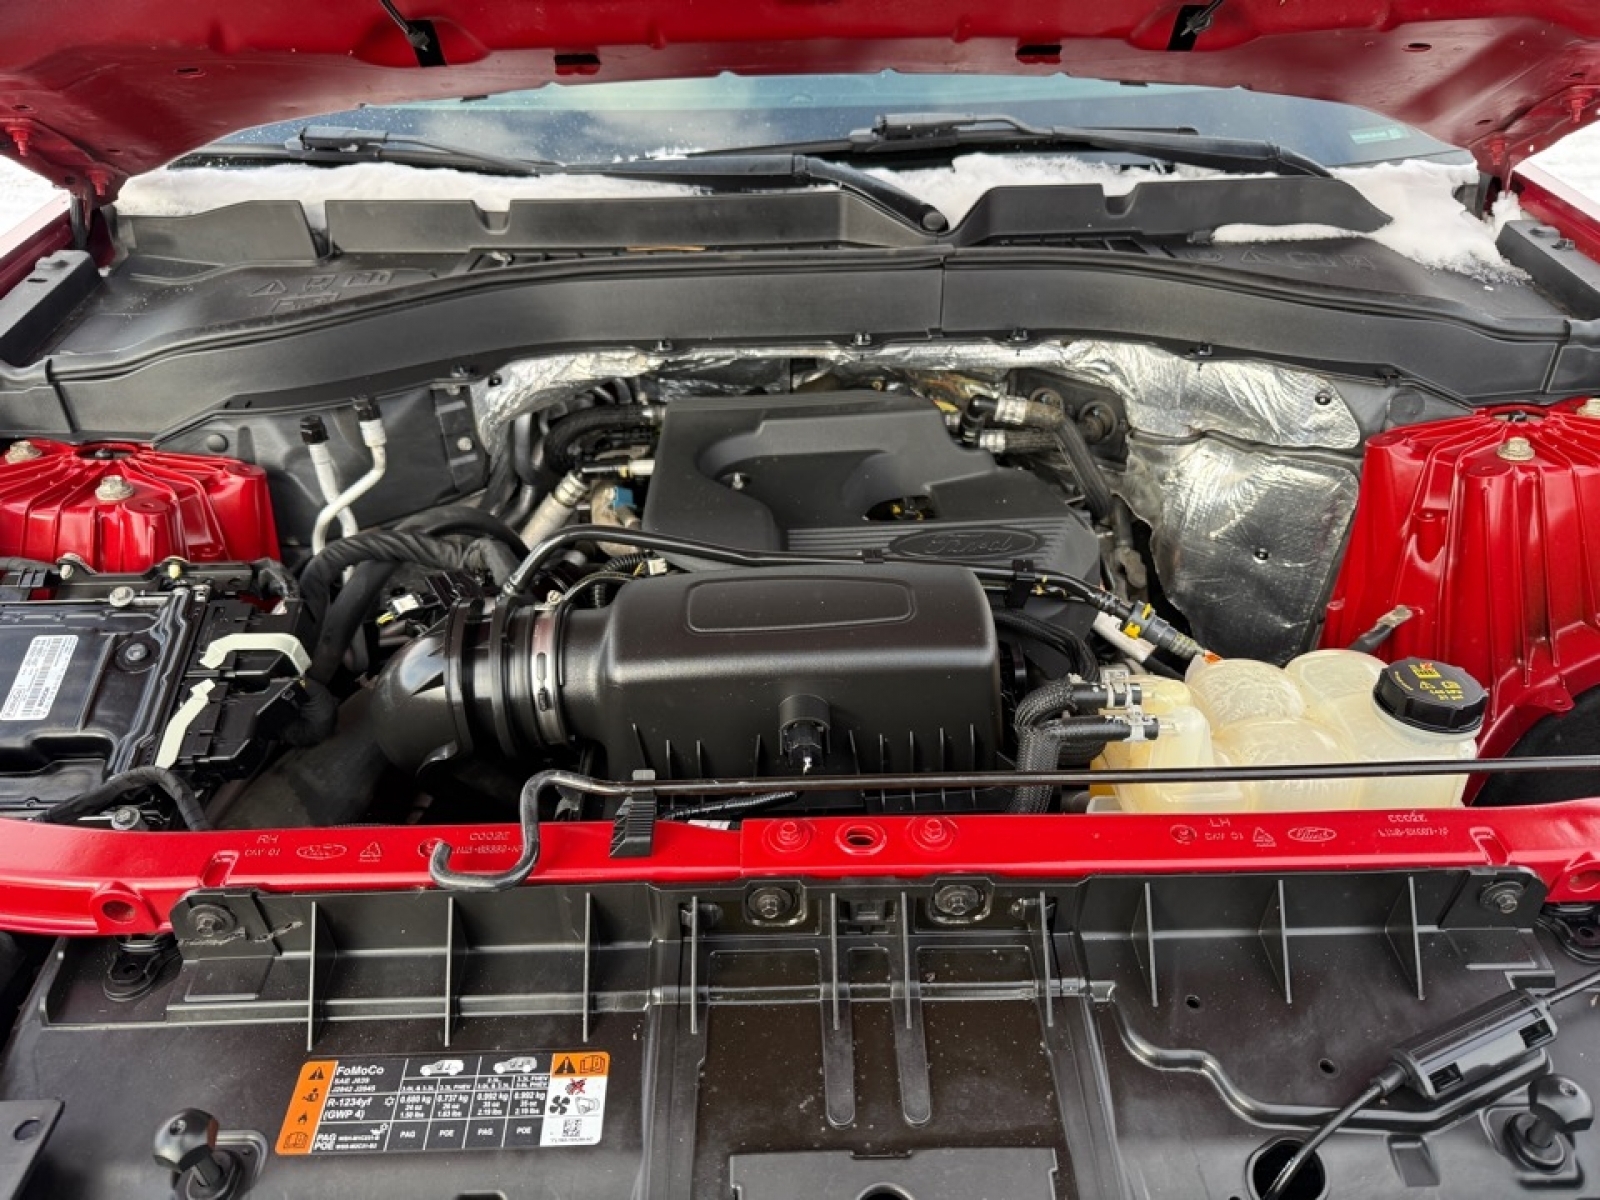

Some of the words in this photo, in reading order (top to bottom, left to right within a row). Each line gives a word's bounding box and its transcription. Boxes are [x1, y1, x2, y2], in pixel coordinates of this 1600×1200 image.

[925, 534, 1012, 554] Ford
[1209, 818, 1231, 827] LH
[257, 835, 278, 844] RH
[336, 1064, 384, 1076] FoMoCo
[422, 1095, 432, 1104] kg
[438, 1094, 458, 1102] 0.737
[458, 1094, 468, 1104] kg
[498, 1092, 508, 1102] kg
[536, 1092, 546, 1100] kg
[326, 1096, 372, 1108] R-1234yf
[322, 1110, 354, 1120] (GWP
[354, 1110, 366, 1120] 4)
[400, 1130, 416, 1138] PAG
[439, 1129, 455, 1138] POE
[477, 1128, 494, 1136] PAG
[516, 1126, 532, 1134] POE
[316, 1133, 337, 1141] PAG
[314, 1141, 336, 1150] POE
